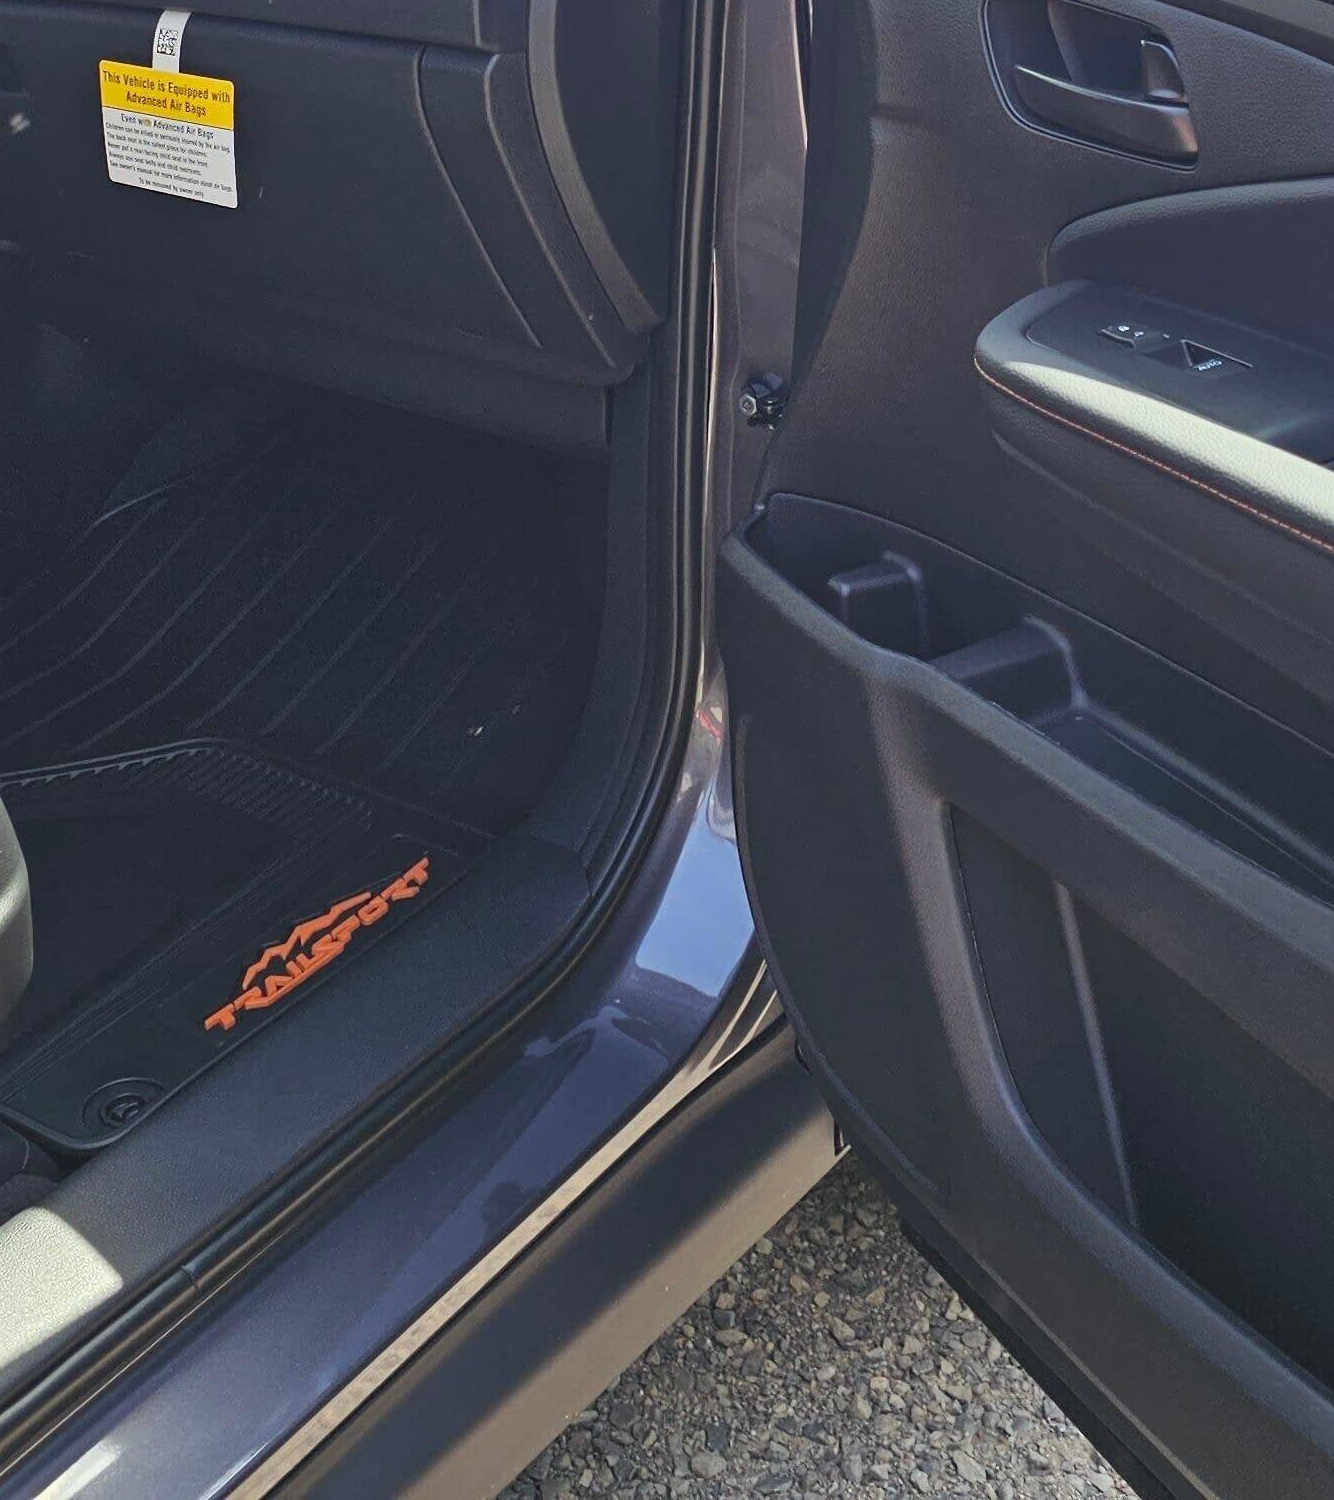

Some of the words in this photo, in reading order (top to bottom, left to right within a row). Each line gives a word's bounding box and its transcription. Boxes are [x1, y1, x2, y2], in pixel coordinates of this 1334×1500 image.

[102, 70, 121, 85] This
[123, 74, 155, 91] Vehicle
[157, 81, 166, 92] is
[168, 81, 209, 100] Equipped
[211, 90, 231, 104] with
[126, 91, 167, 109] Advanced
[170, 98, 183, 111] Air
[185, 101, 207, 117] Bags
